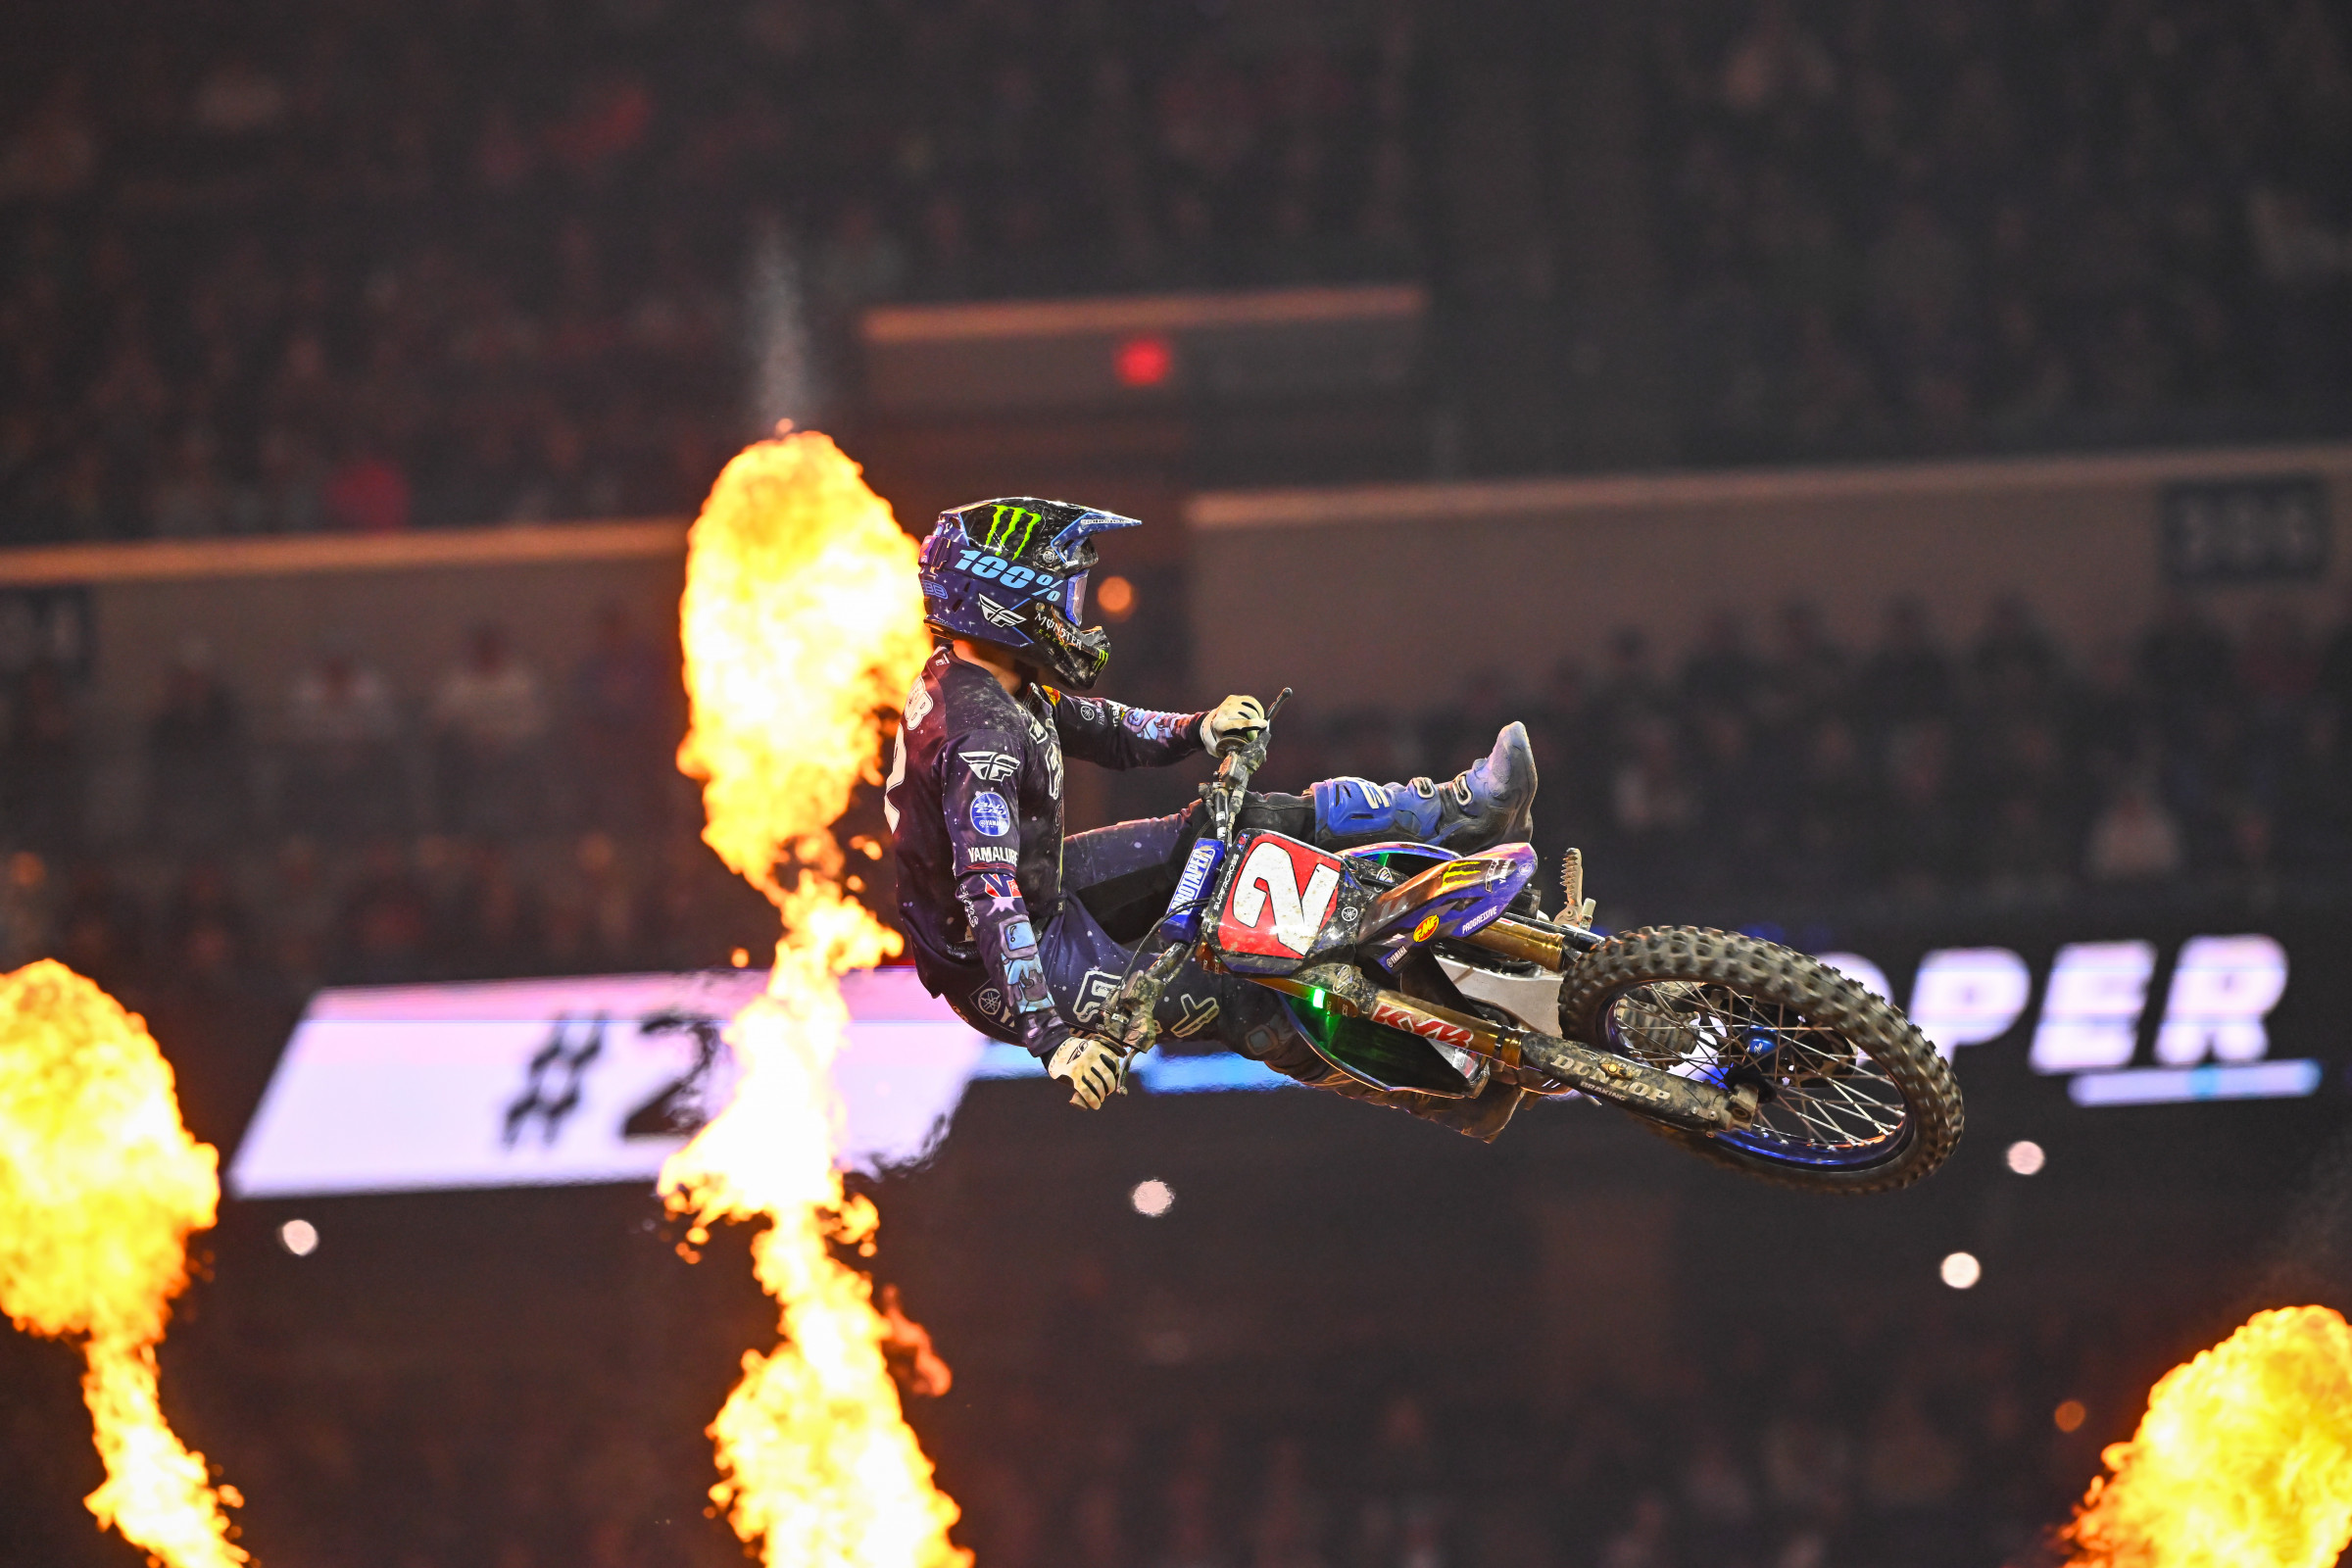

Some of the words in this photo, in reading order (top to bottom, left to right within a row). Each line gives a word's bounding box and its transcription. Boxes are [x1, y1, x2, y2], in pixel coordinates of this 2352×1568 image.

[955, 549, 1063, 602] 100%
[1035, 612, 1083, 651] MONSTER
[967, 846, 1018, 867] YAMALUBE
[1213, 853, 1240, 911] SUPERCROSS
[1232, 841, 1341, 956] 2
[1413, 913, 1440, 943] FMF
[1461, 906, 1498, 935] PROGRESSIVE
[1391, 945, 1408, 964] YAMAHA
[504, 1010, 723, 1150] #2
[1549, 1054, 1671, 1102] DUNLOP
